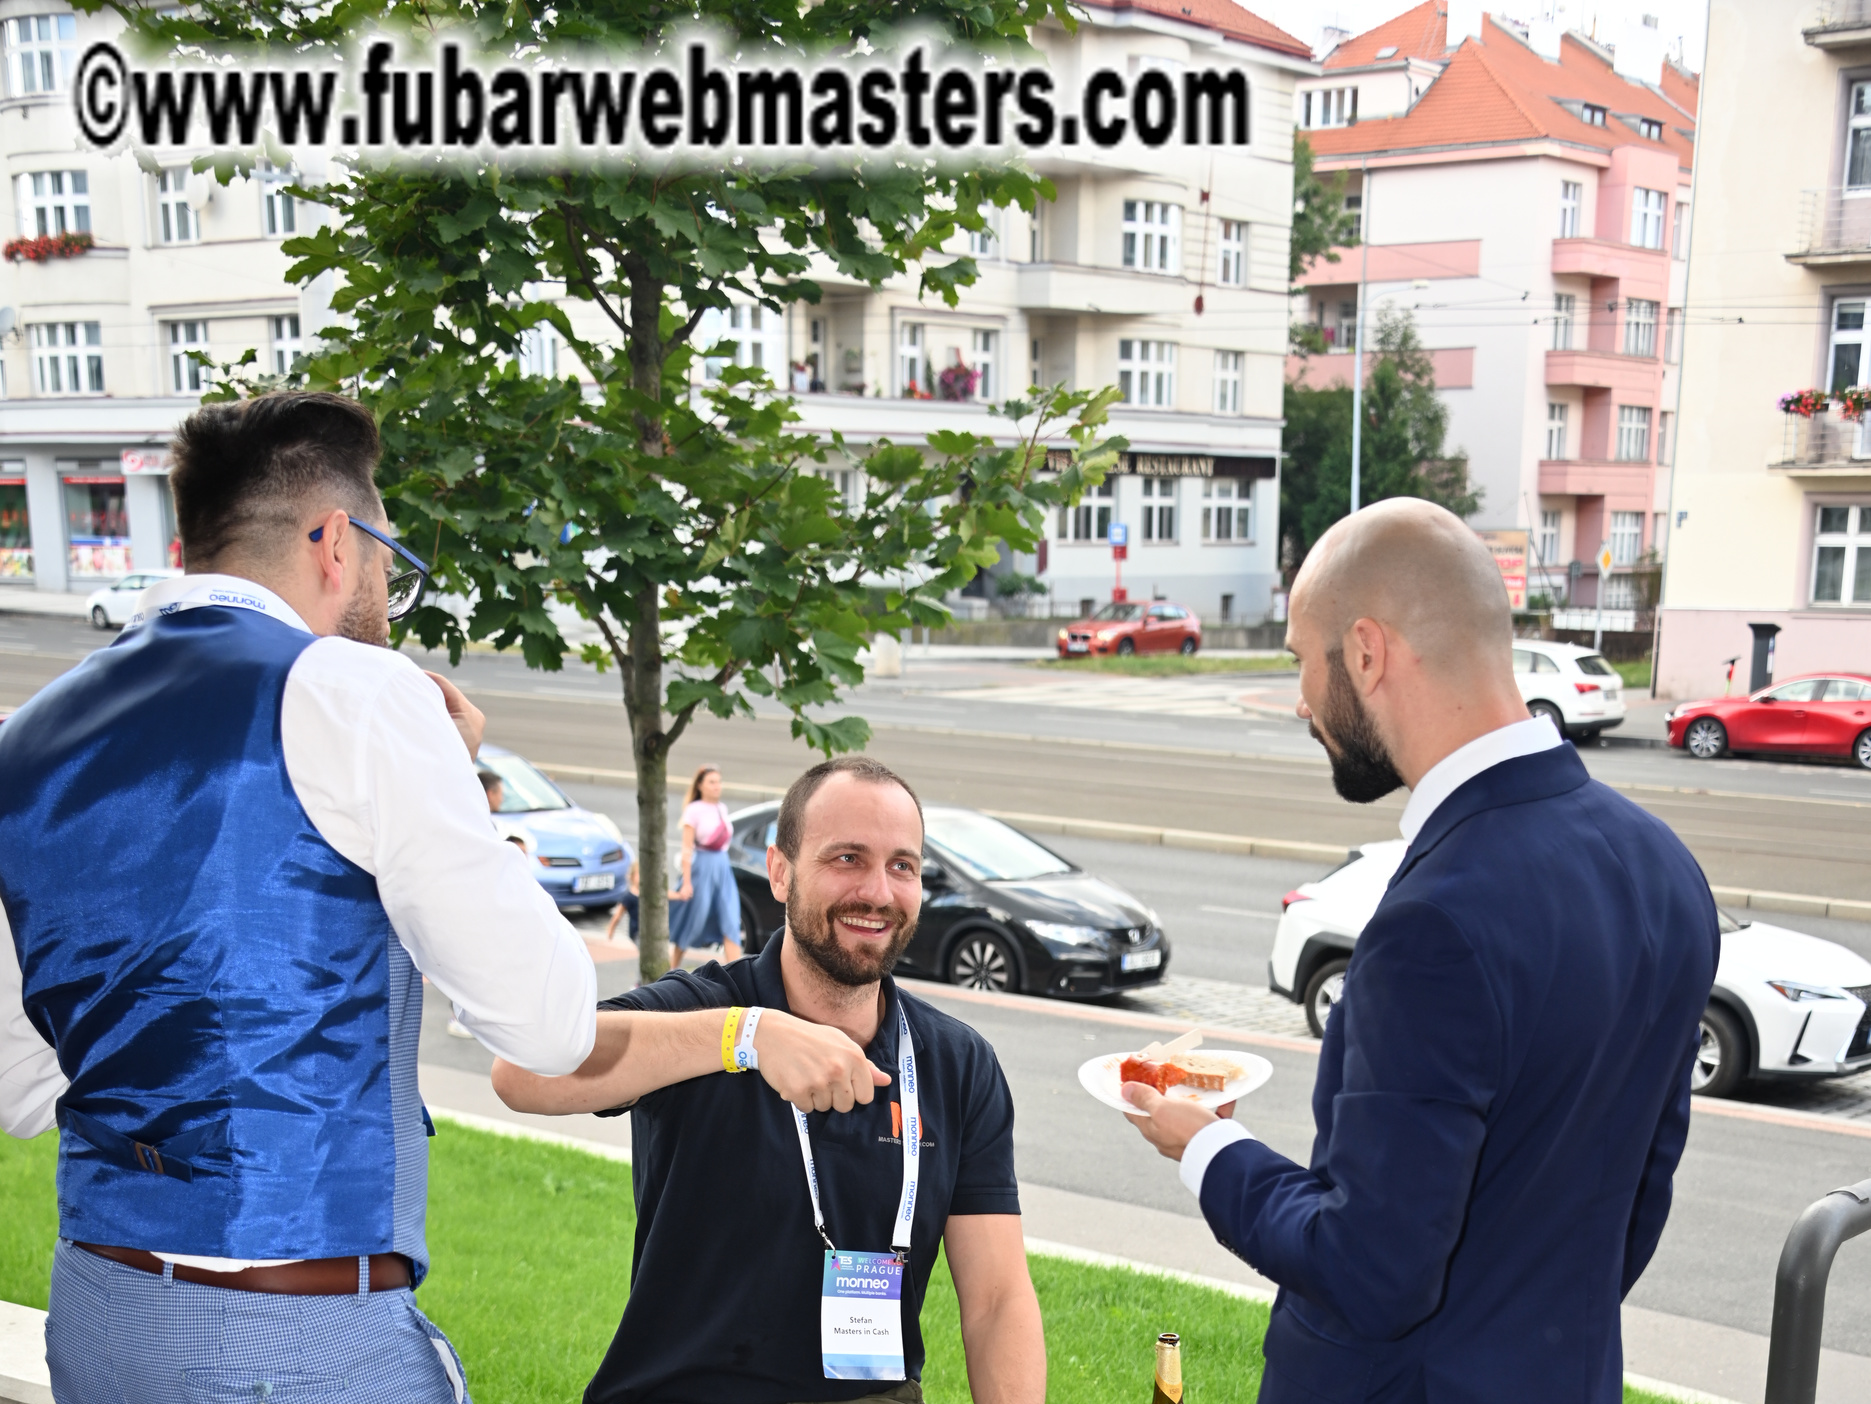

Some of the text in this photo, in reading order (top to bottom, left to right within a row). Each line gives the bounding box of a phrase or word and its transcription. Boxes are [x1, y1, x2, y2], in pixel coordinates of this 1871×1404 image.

[208, 593, 266, 610] monneo
[906, 1055, 915, 1094] monneo
[904, 1180, 916, 1222] monneo
[858, 1257, 891, 1265] WELCOME
[856, 1264, 901, 1276] PRAGUE
[836, 1276, 890, 1290] monneo
[849, 1316, 873, 1324] Stefan
[833, 1327, 862, 1335] Masters
[872, 1328, 890, 1336] Cash
